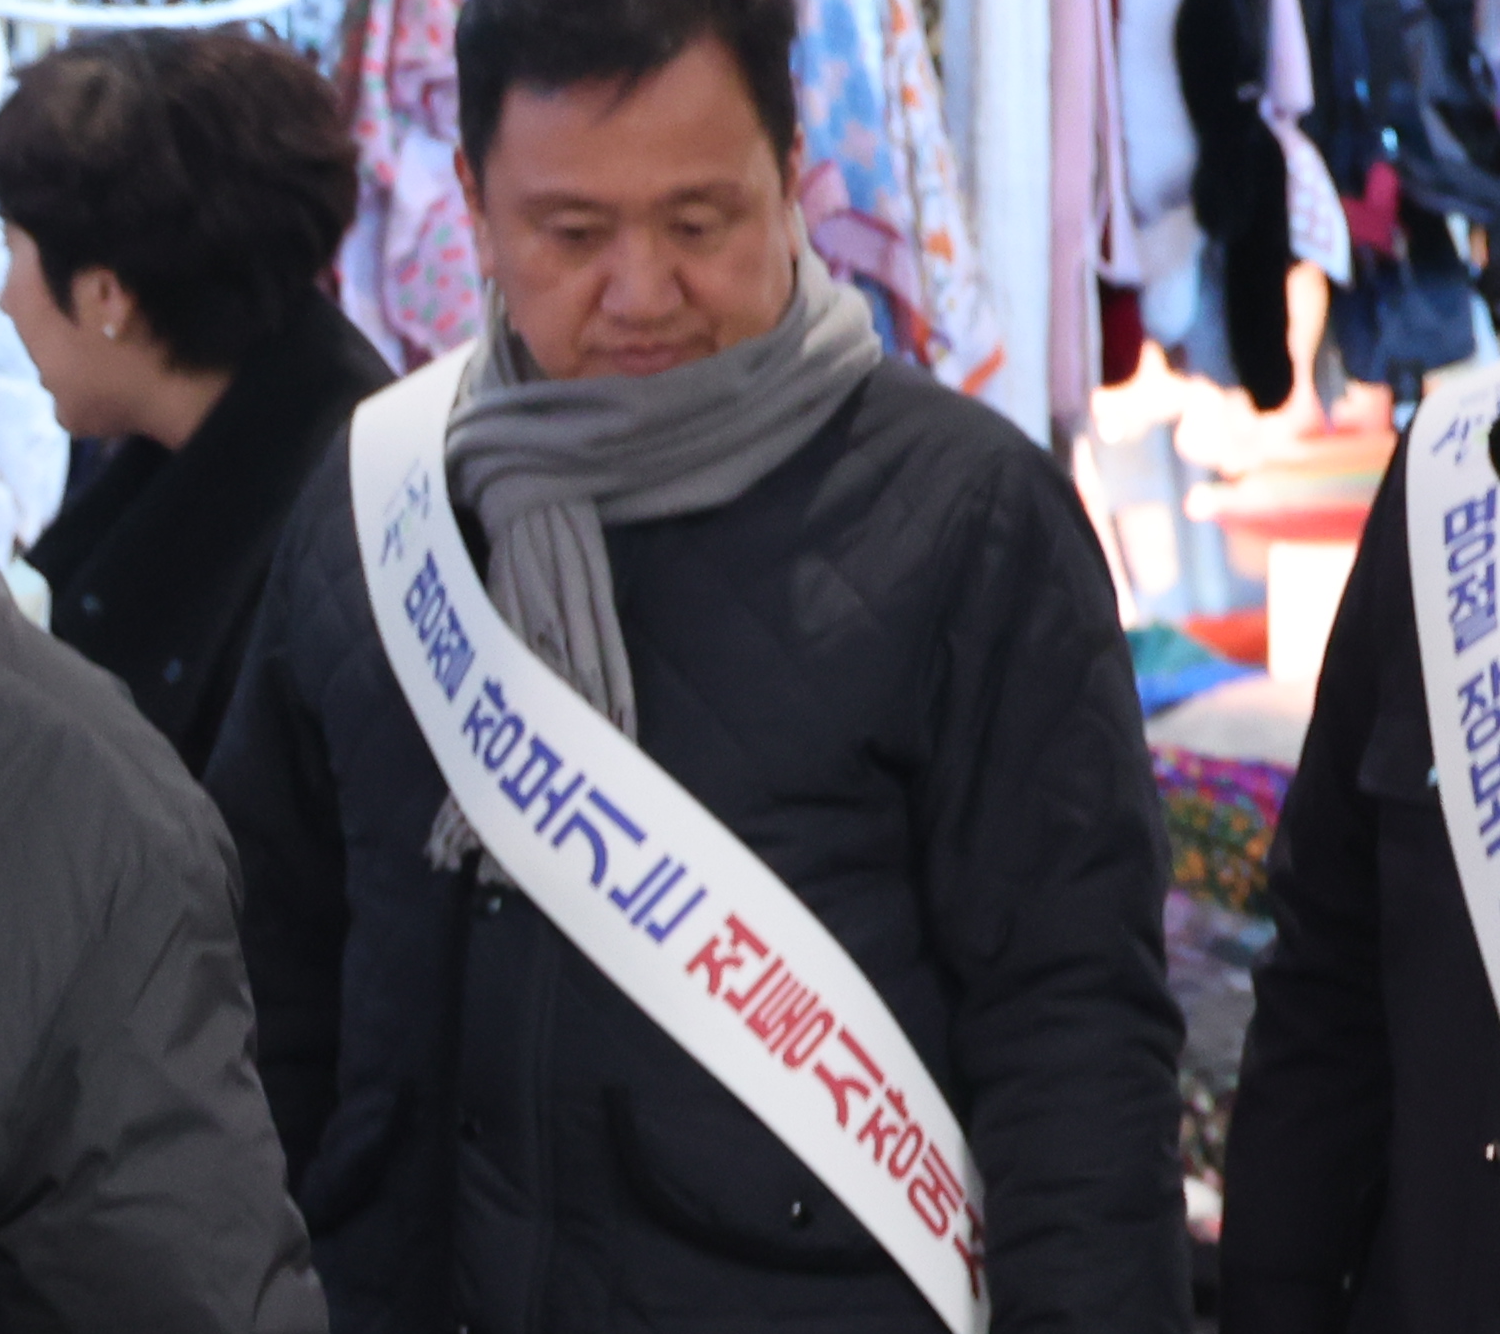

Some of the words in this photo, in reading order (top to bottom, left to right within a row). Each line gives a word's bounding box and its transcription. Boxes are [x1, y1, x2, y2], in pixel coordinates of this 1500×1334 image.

[1444, 485, 1498, 658] 명절
[402, 547, 472, 706] 명절
[460, 679, 708, 946] 장보기는
